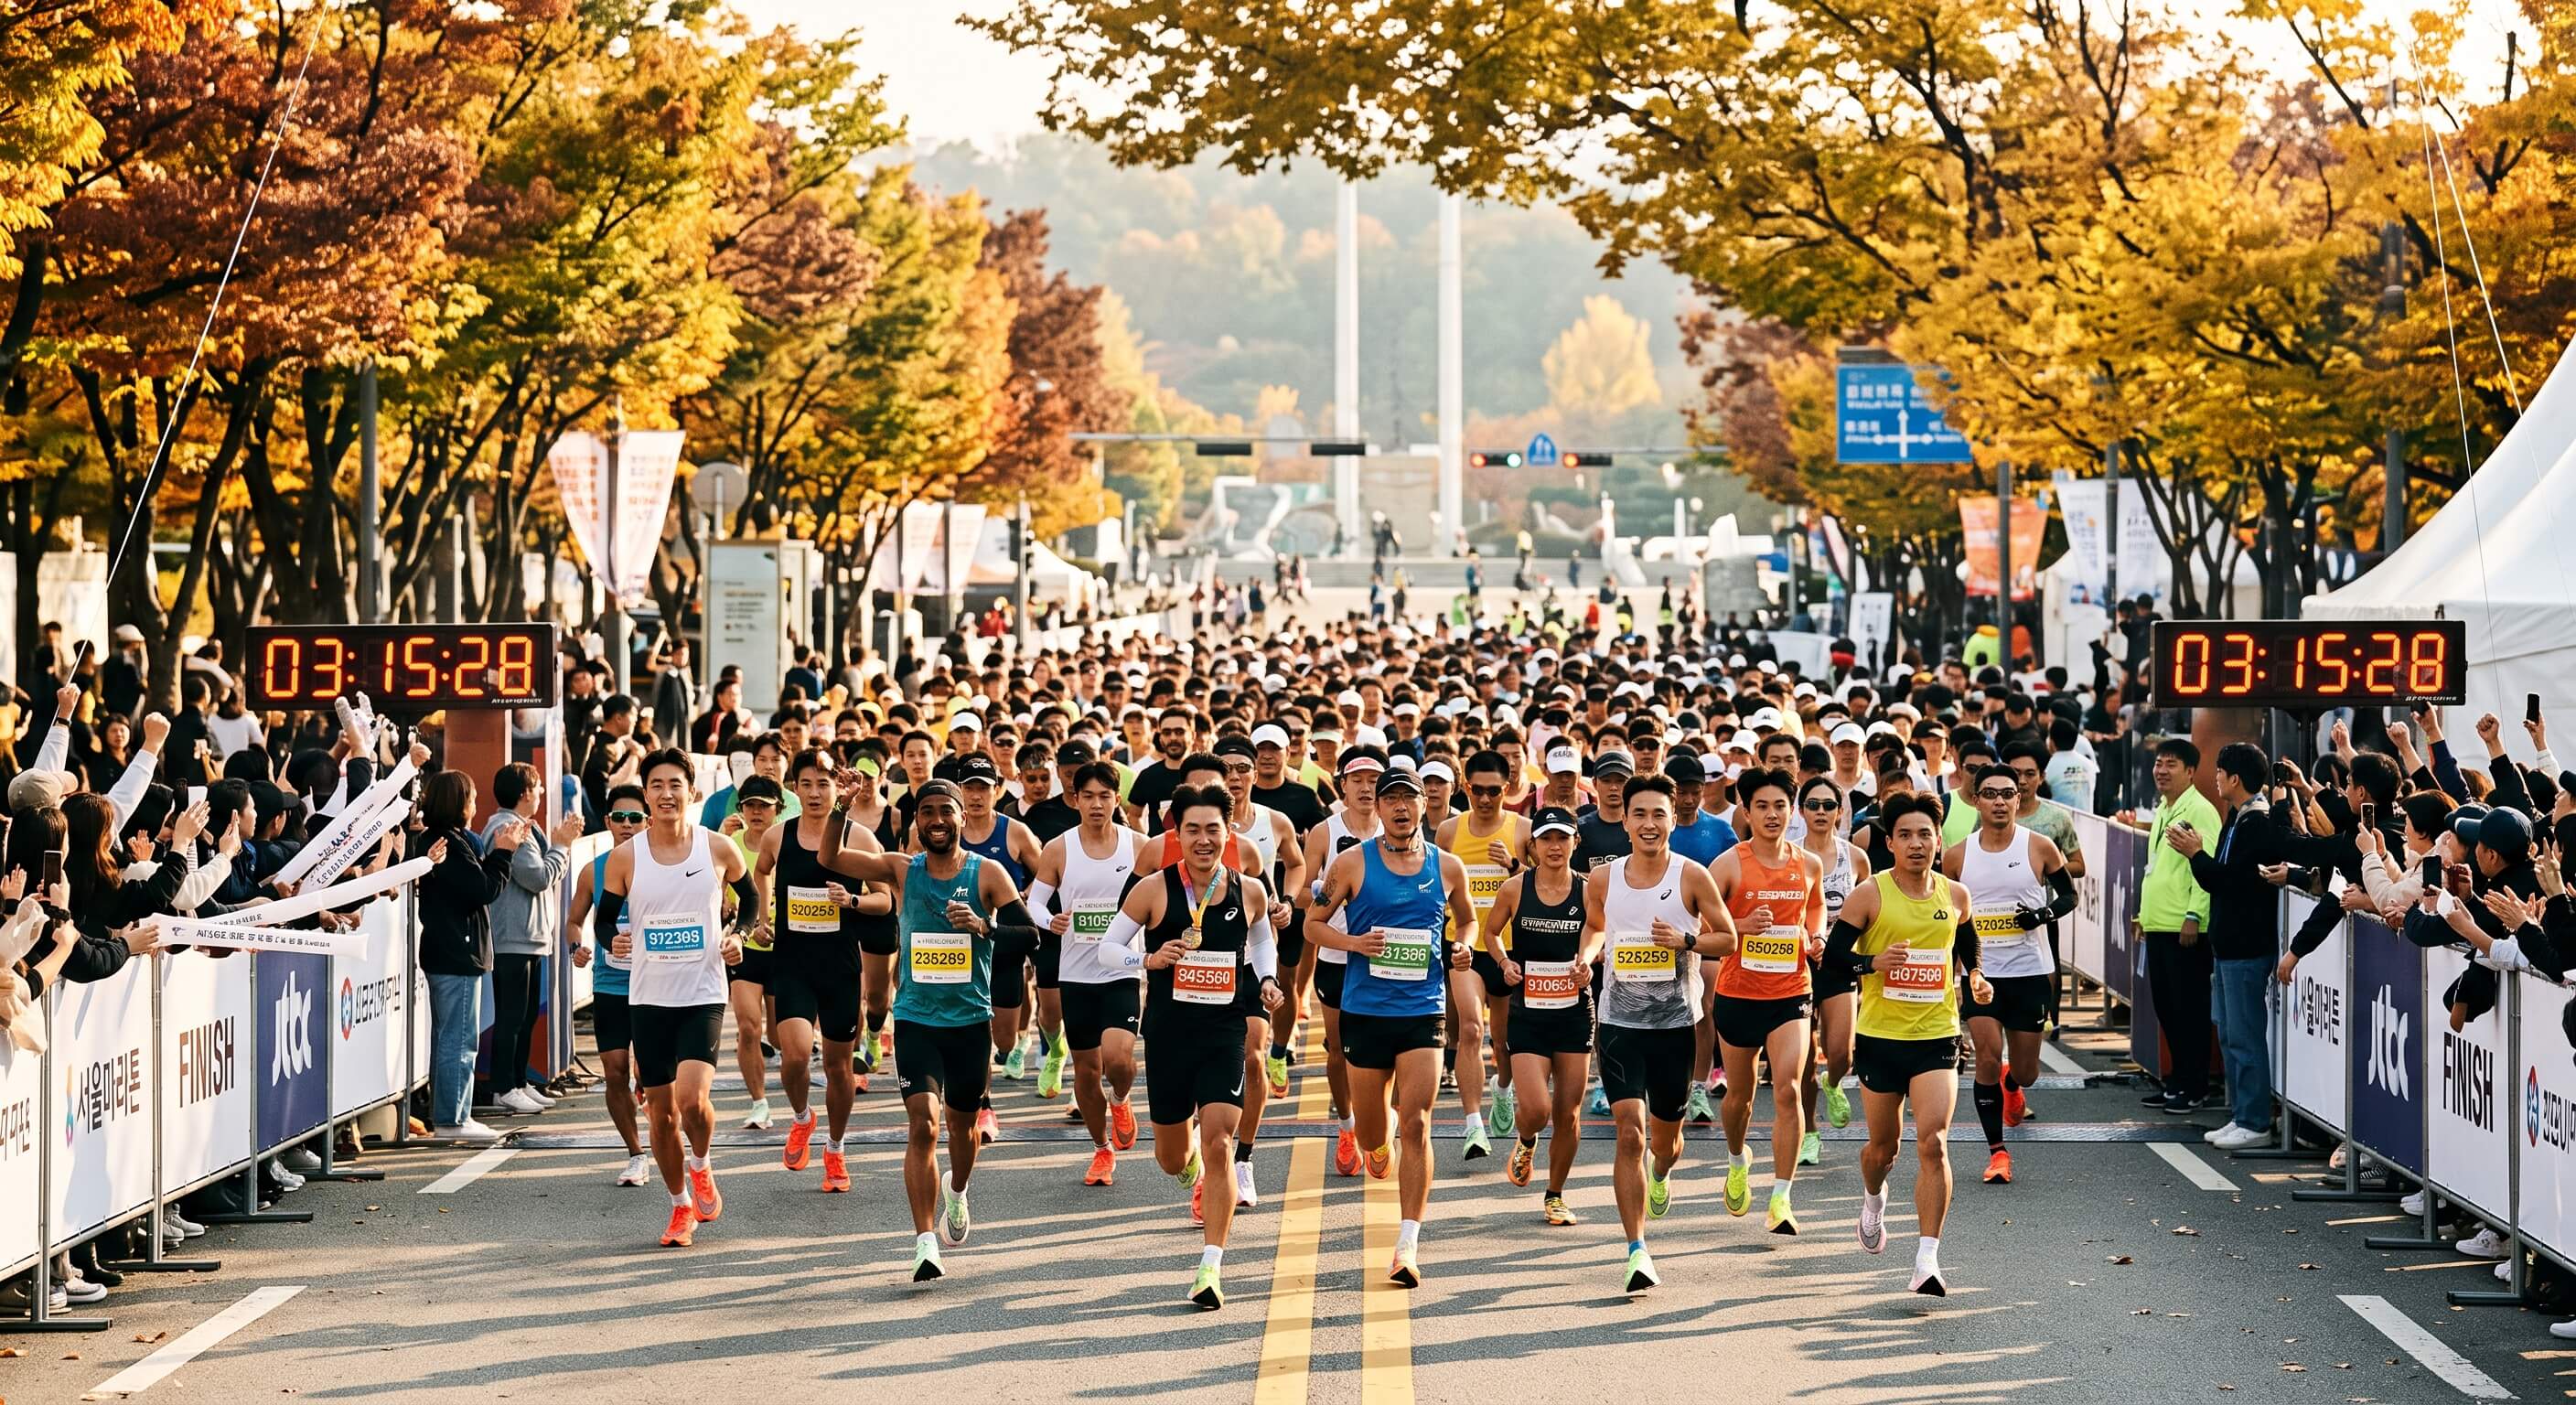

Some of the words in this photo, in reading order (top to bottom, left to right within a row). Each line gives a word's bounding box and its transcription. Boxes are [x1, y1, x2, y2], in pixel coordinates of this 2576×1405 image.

[264, 636, 534, 699] 03:15:28
[2174, 633, 2446, 693] 03:15:28
[1746, 940, 1794, 955] 650258
[77, 1047, 141, 1134] 서울마리톤
[179, 1015, 234, 1109] FINISH
[2443, 1031, 2494, 1133] FINISH
